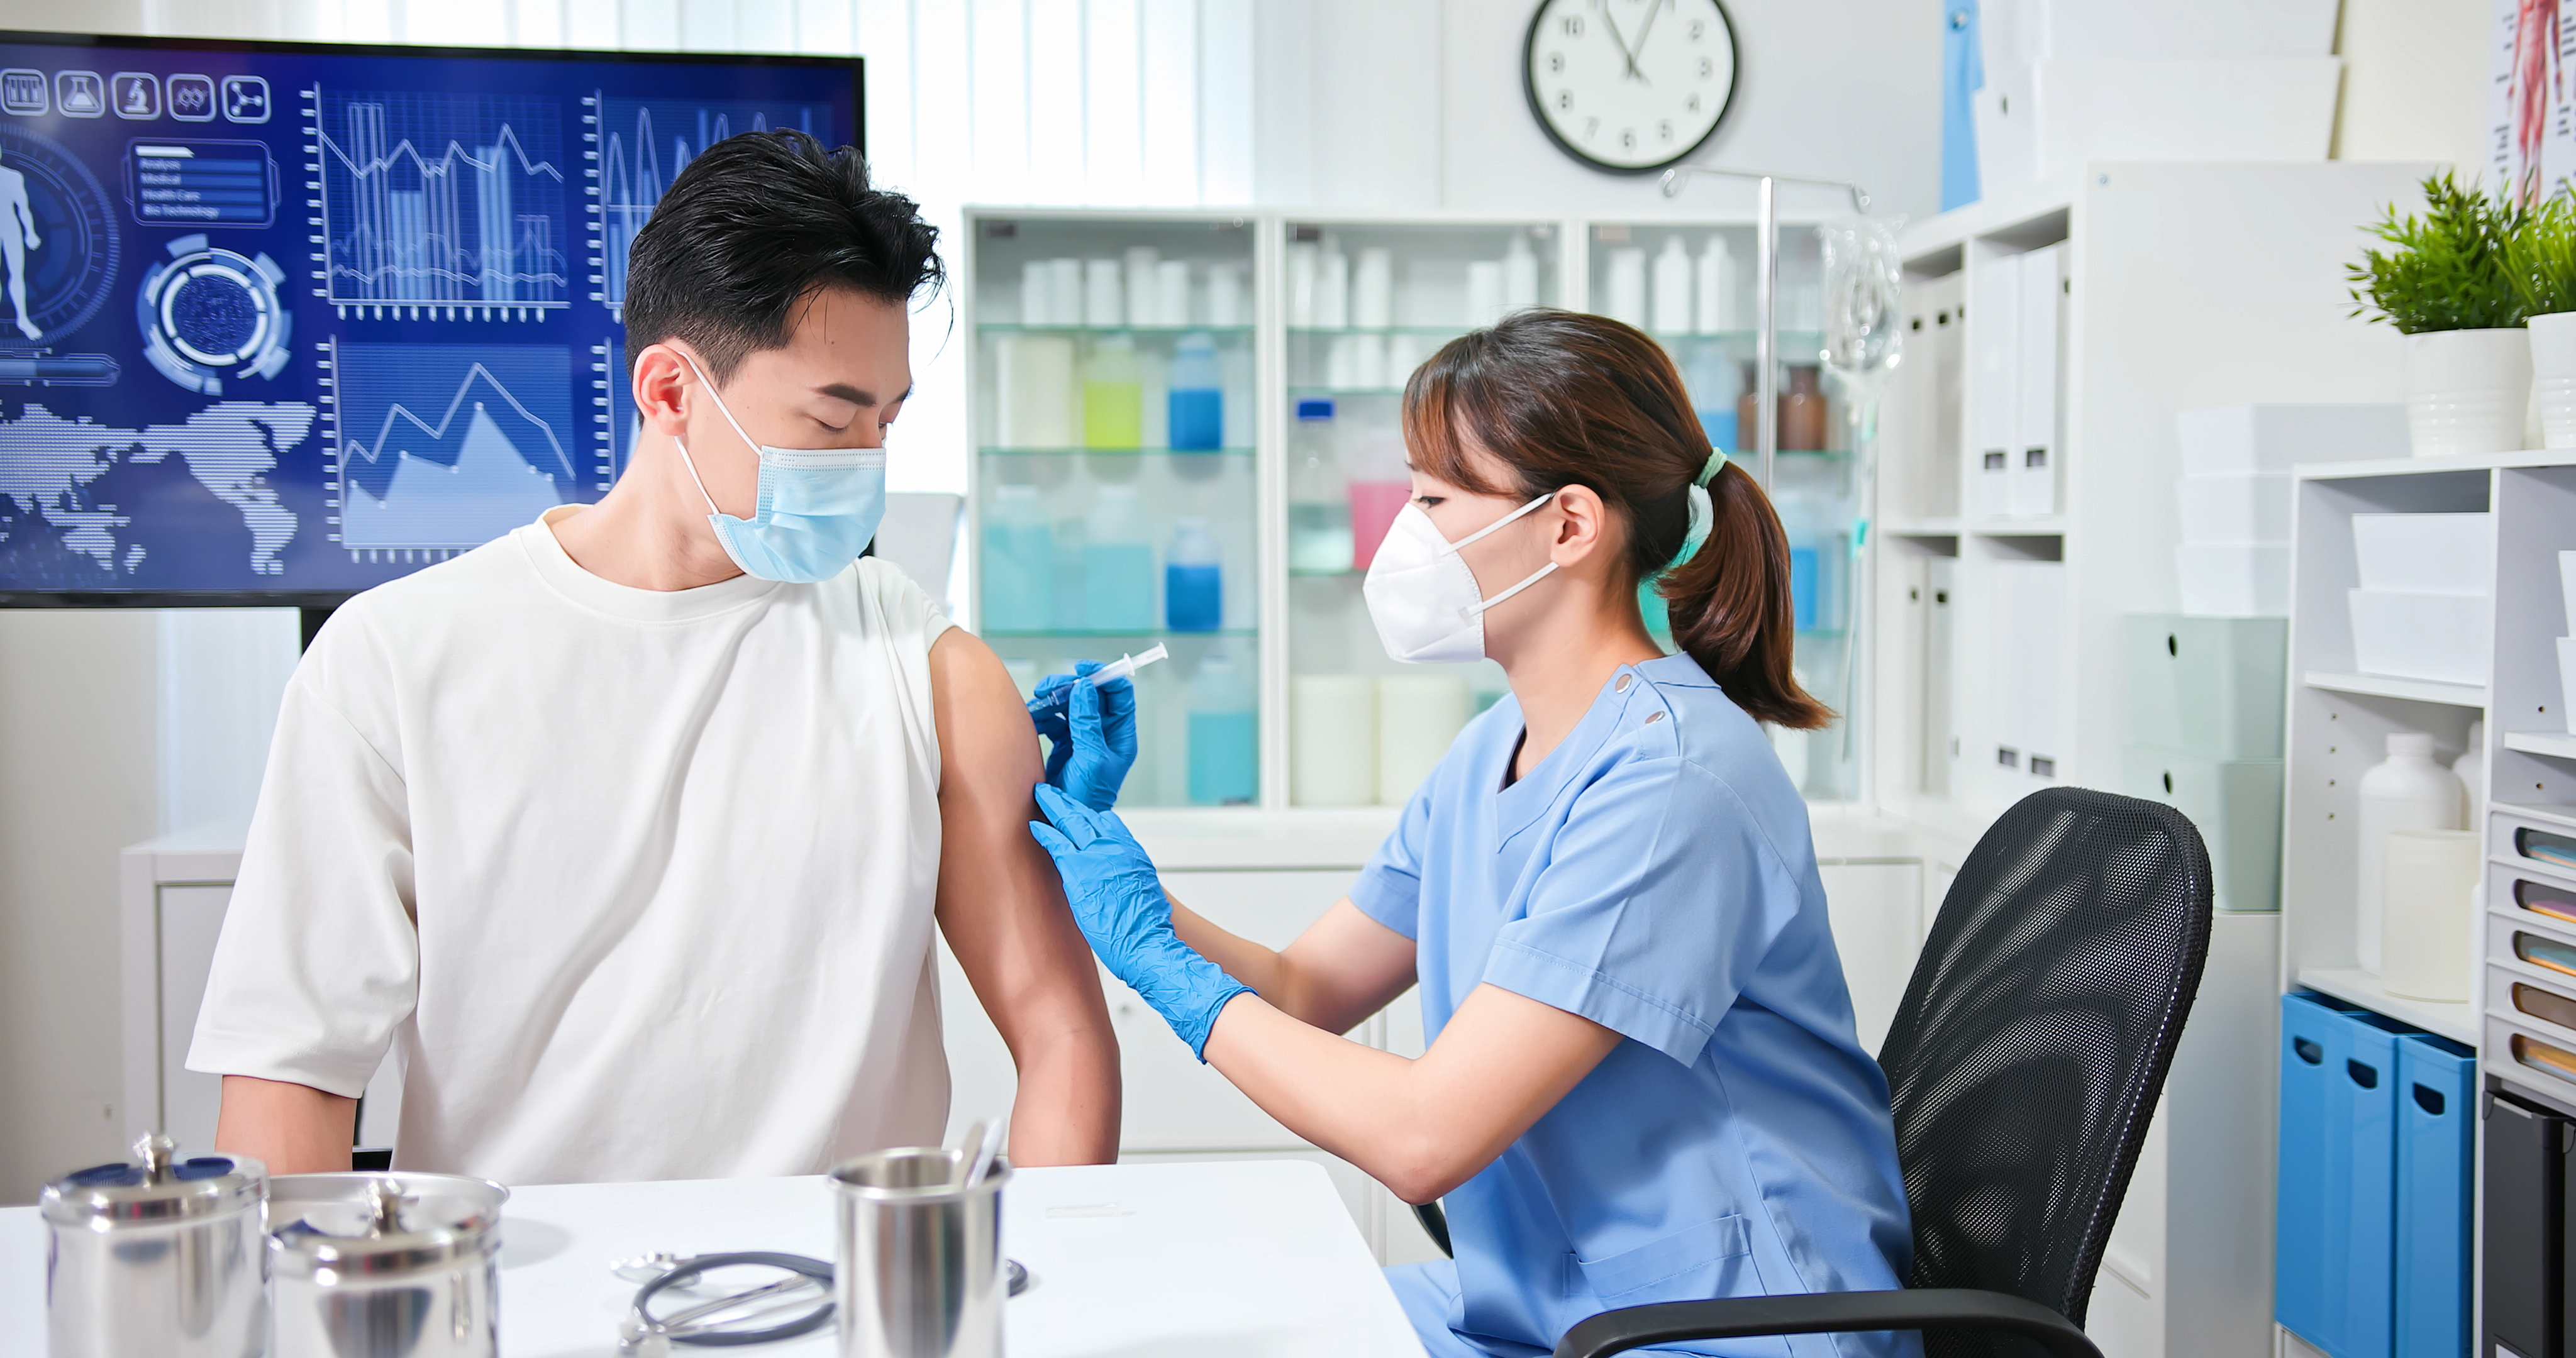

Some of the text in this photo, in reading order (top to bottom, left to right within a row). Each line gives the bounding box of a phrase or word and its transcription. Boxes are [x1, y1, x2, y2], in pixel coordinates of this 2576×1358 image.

[1561, 16, 1584, 38] 10
[1687, 19, 1704, 42] 2
[140, 172, 181, 185] Medical
[142, 188, 201, 201] Health Care
[162, 205, 219, 220] Technology
